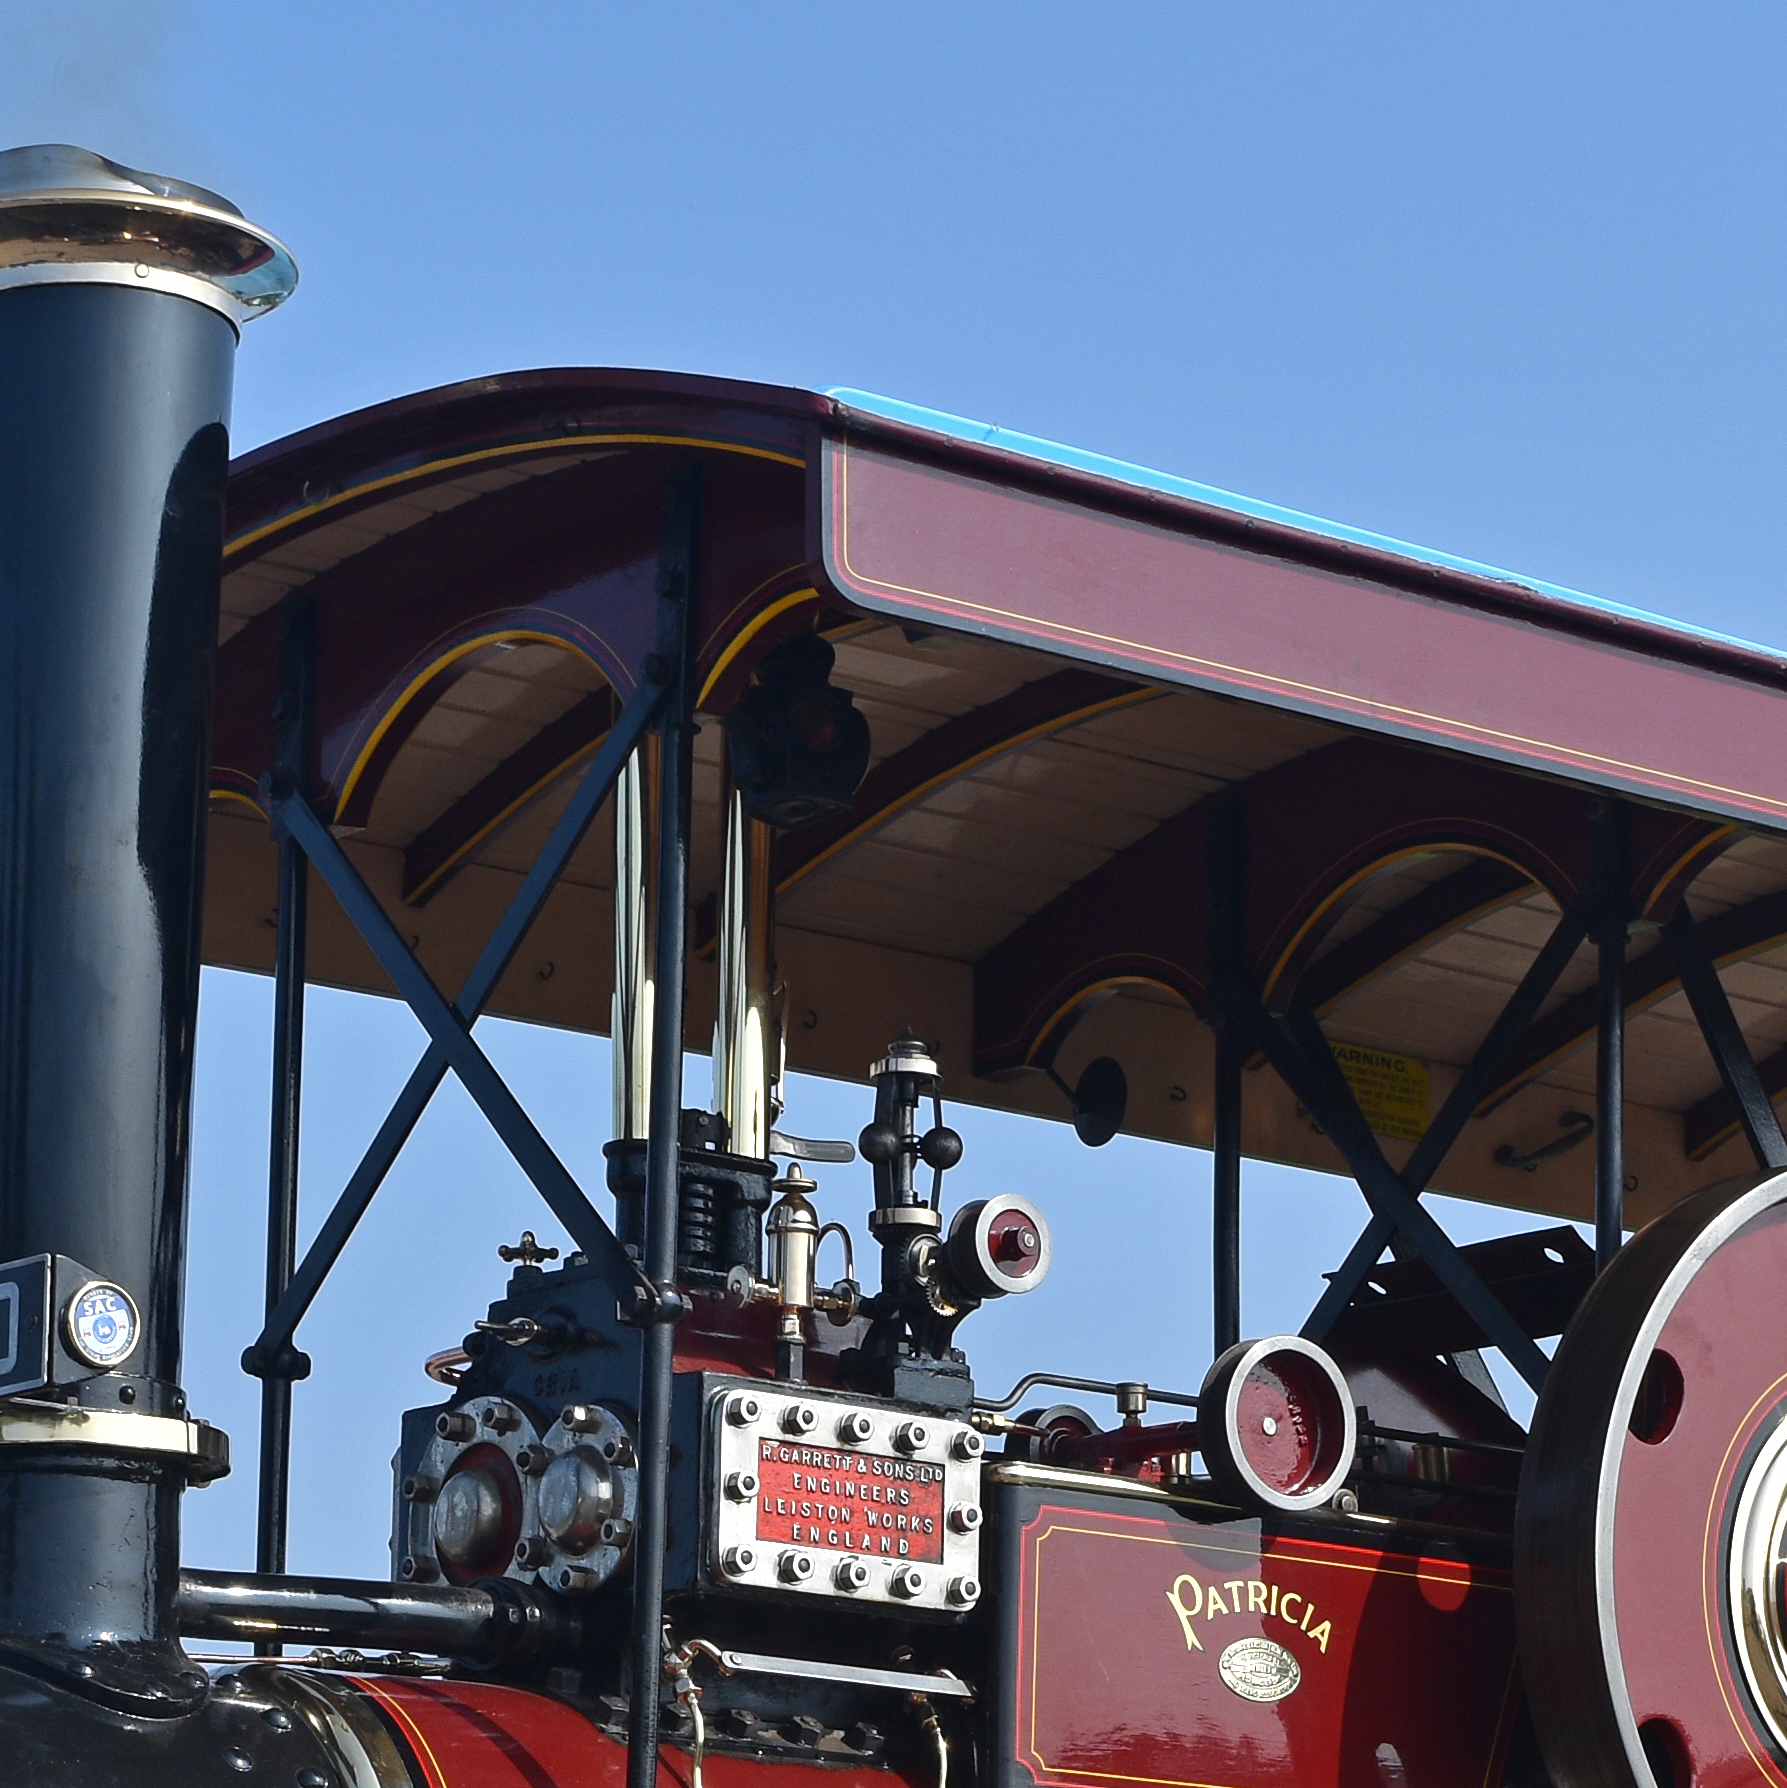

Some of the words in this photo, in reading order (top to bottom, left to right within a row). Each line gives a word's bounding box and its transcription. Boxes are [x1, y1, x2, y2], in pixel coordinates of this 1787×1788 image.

[1332, 1046, 1409, 1074] ARNING.
[83, 1296, 117, 1316] SAC
[857, 1459, 867, 1474] &
[872, 1460, 915, 1480] SONS
[792, 1472, 910, 1505] ENGINEERS
[763, 1496, 852, 1523] LEISTON
[865, 1507, 934, 1534] WORKS
[792, 1523, 910, 1555] ENGLAND
[1165, 1573, 1333, 1655] PATRICIA
